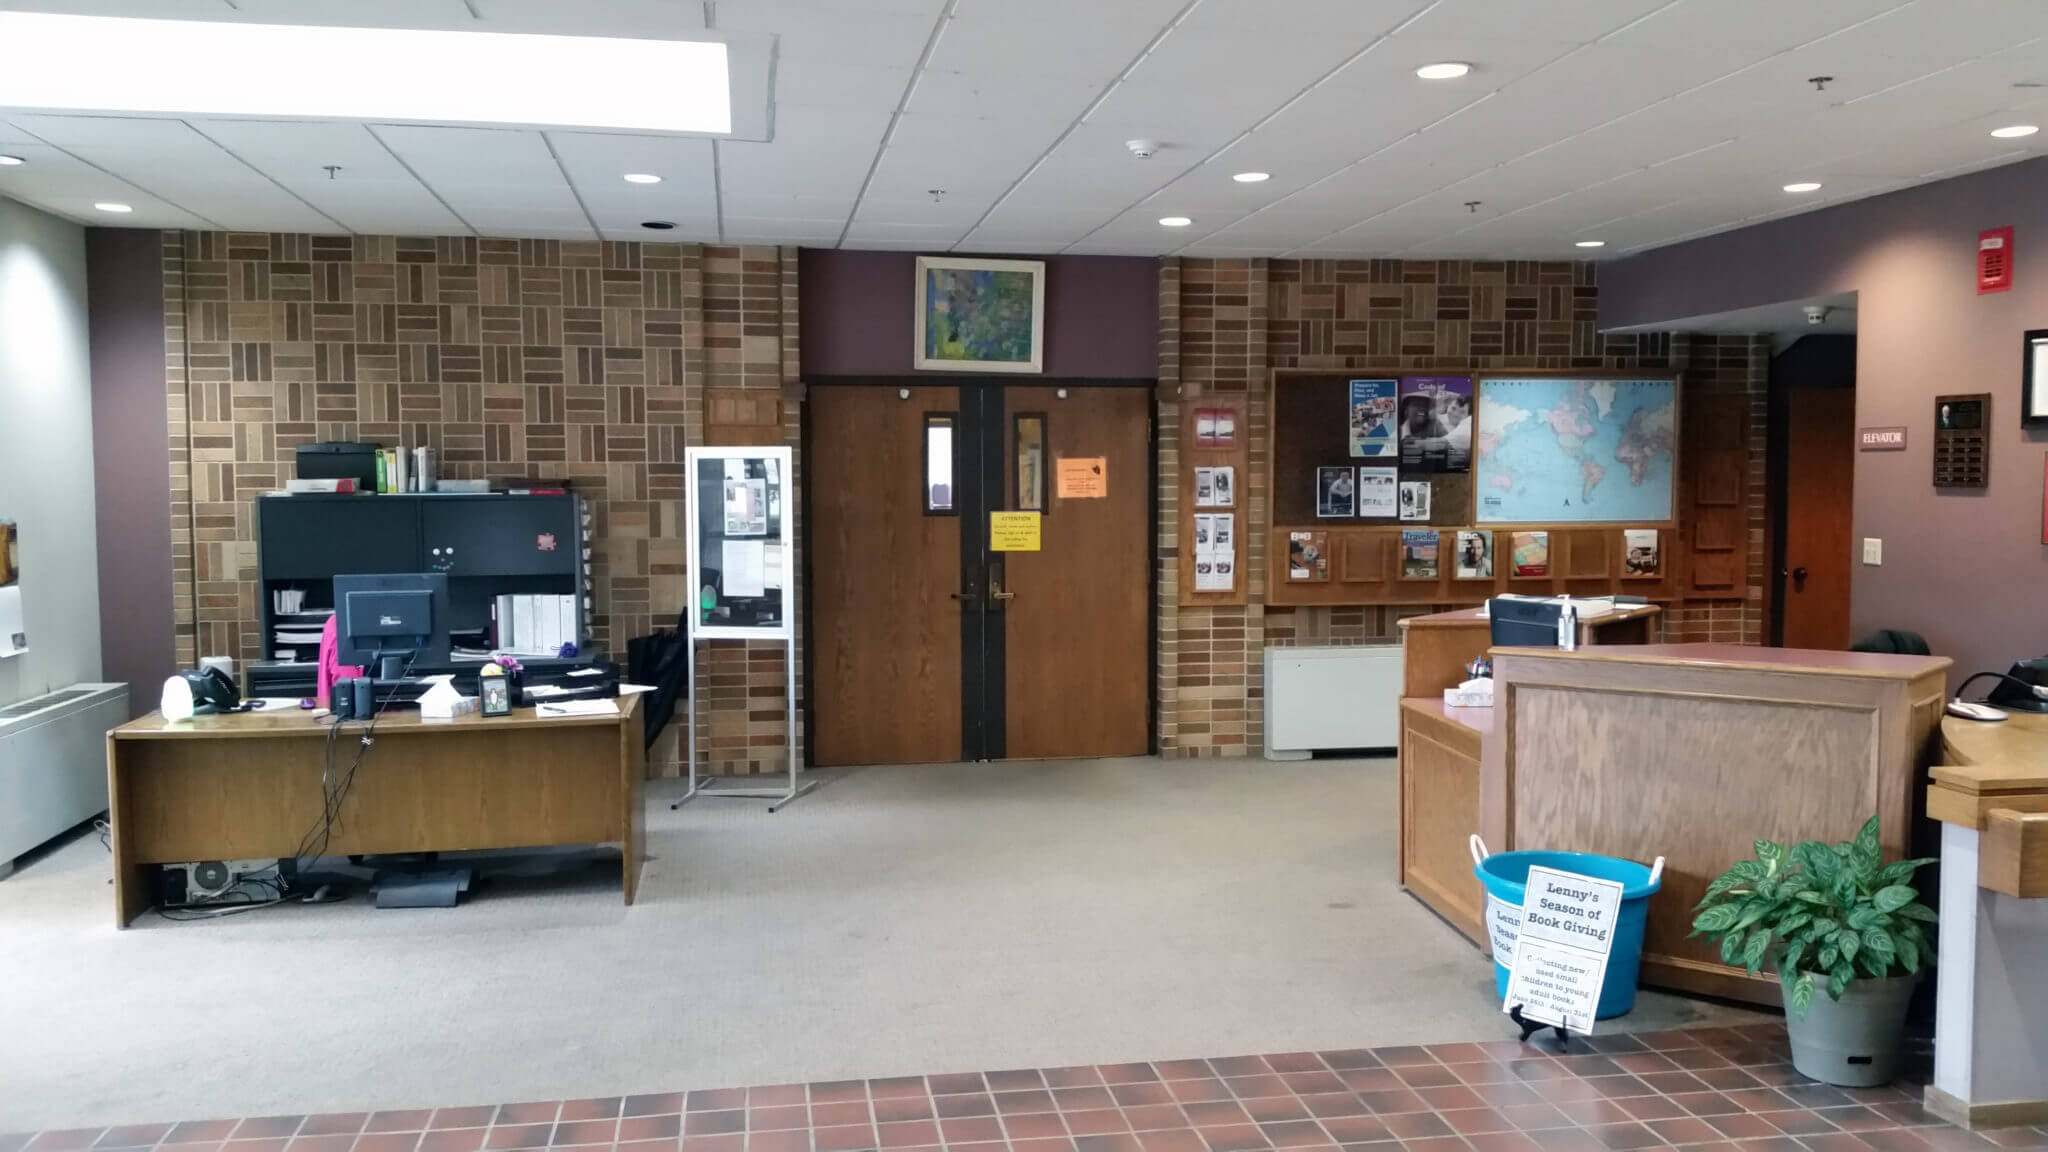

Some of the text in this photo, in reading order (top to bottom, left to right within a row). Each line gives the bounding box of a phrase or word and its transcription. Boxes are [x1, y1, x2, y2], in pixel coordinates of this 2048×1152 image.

[1863, 432, 1903, 443] ELEVATOR
[1404, 531, 1438, 541] Traveler
[1546, 882, 1600, 903] Lenny's
[1539, 898, 1602, 921] Season of
[1496, 910, 1521, 927] Lenn
[1528, 912, 1607, 941] Book Giving
[1529, 988, 1575, 1006] adult books
[1564, 985, 1590, 999] young
